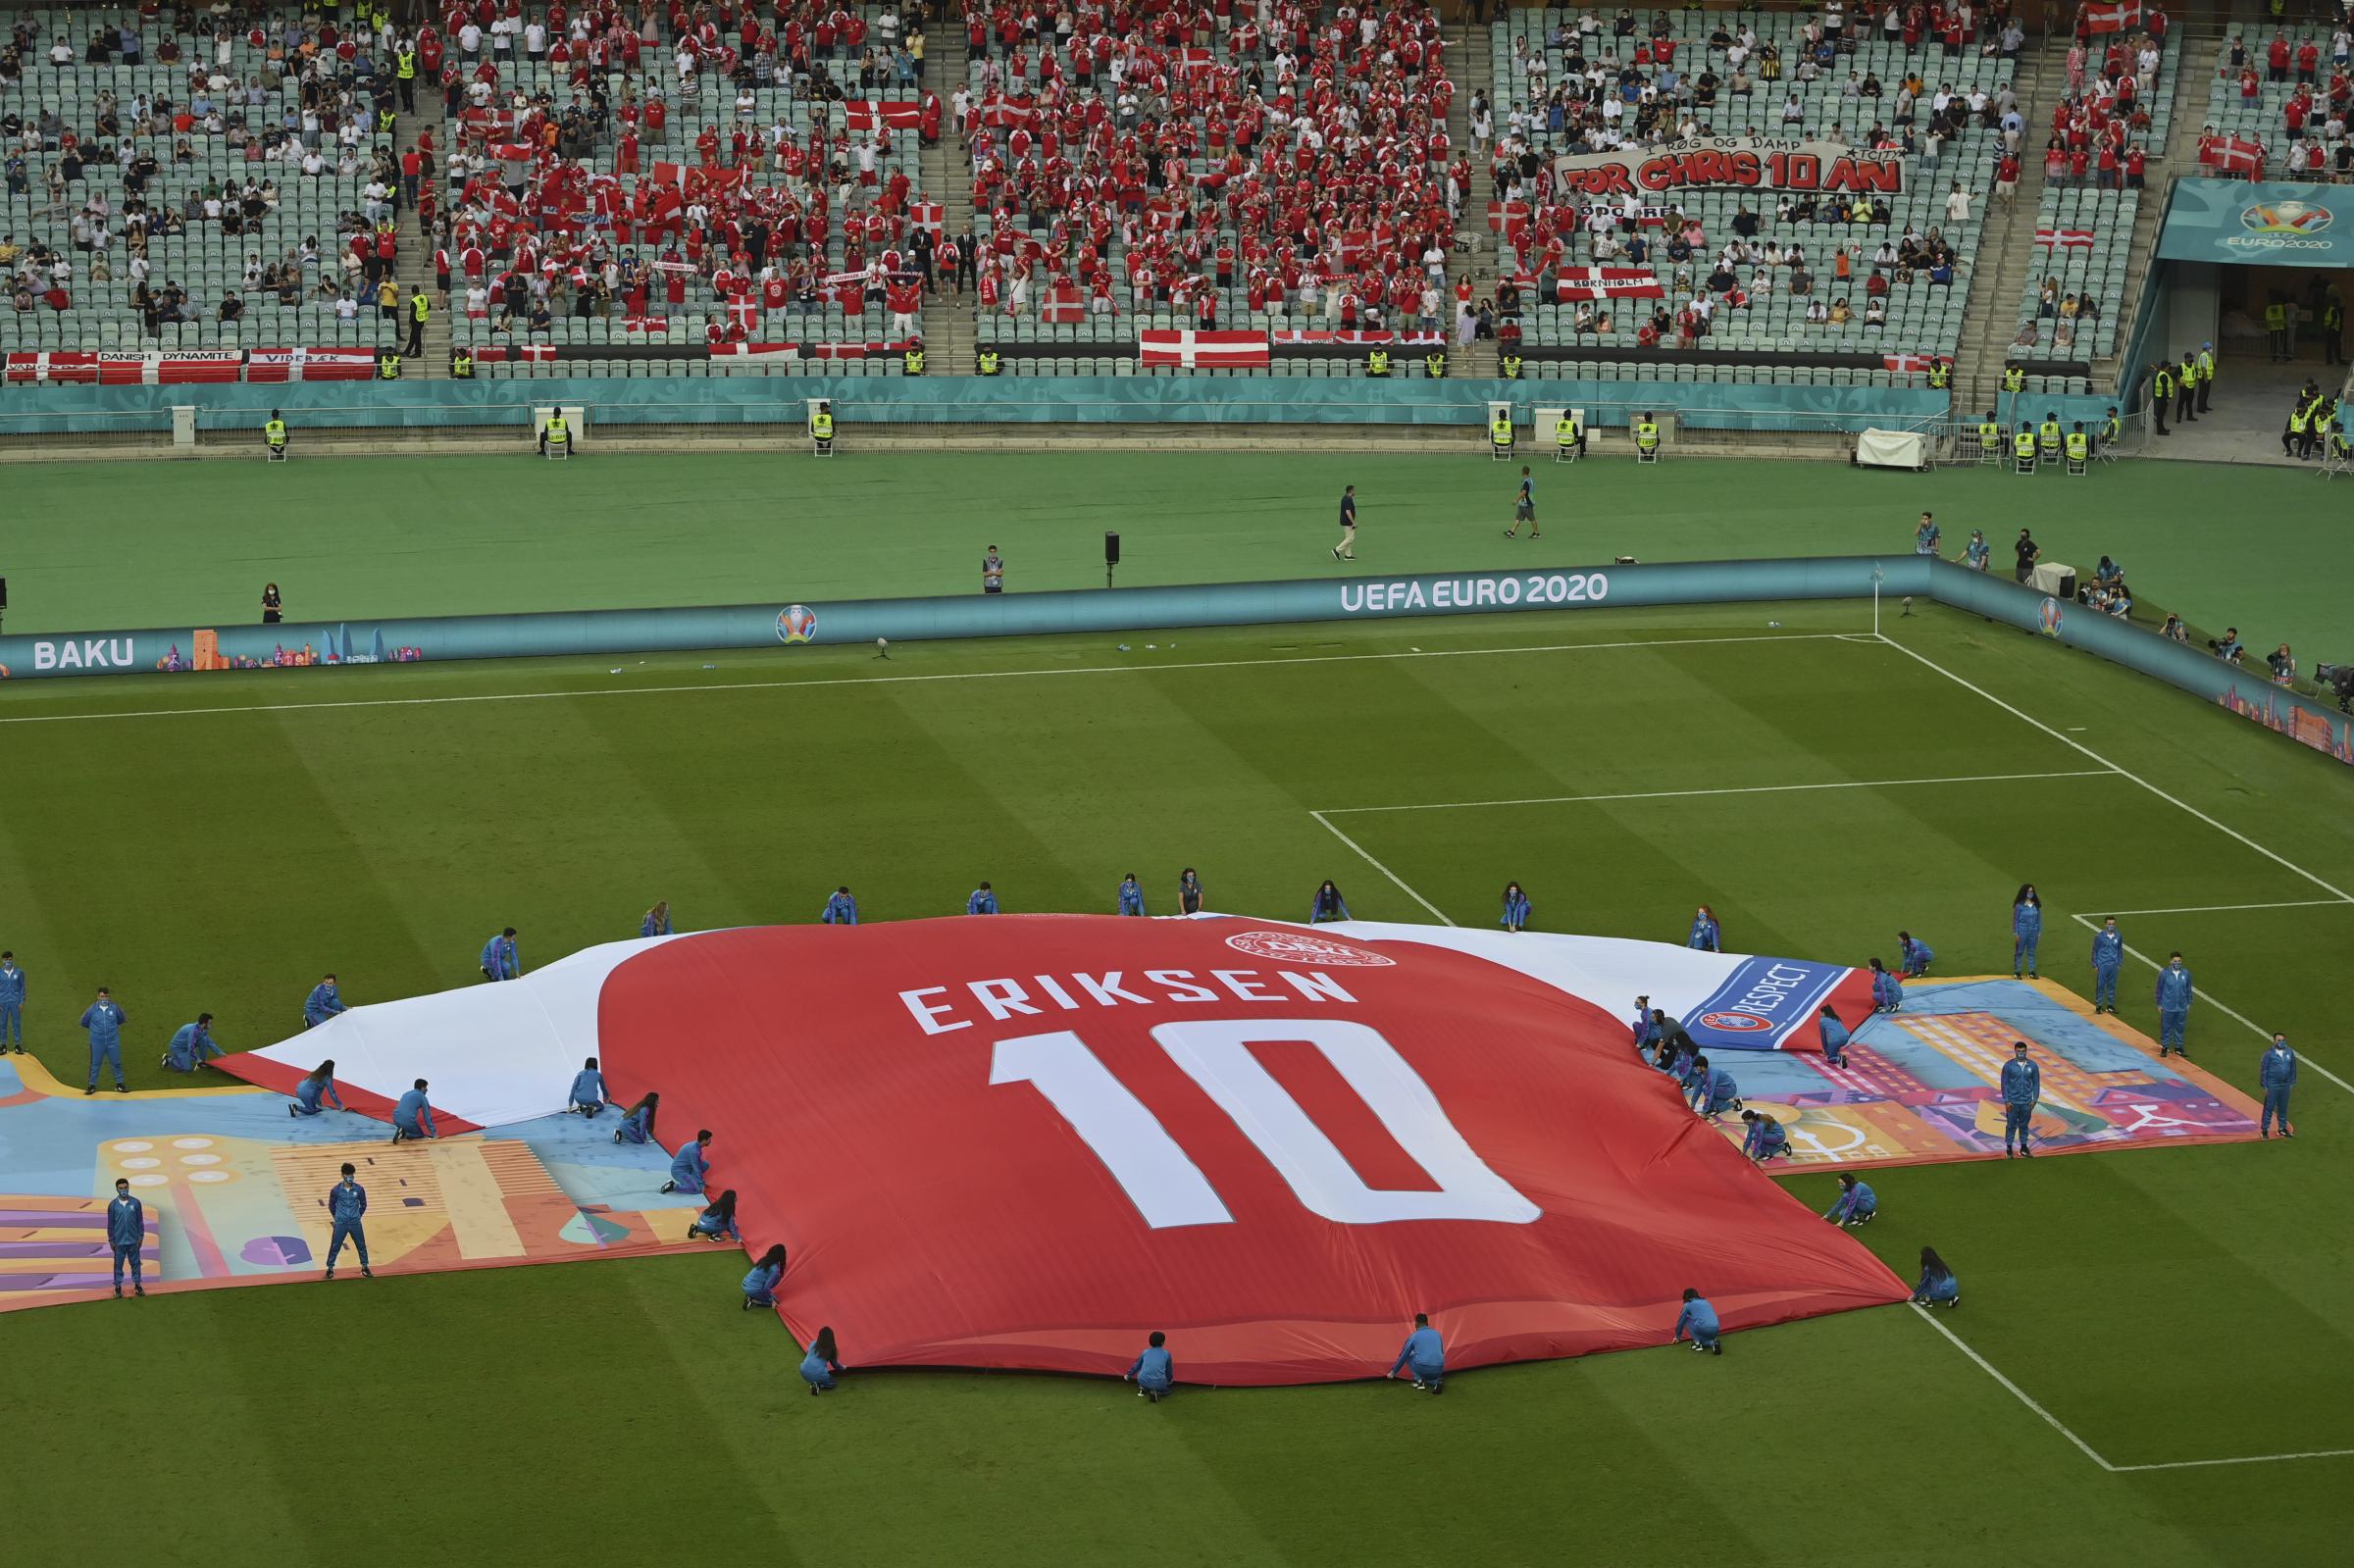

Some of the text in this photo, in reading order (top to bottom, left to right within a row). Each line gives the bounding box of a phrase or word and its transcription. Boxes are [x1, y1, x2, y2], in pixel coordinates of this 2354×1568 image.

[1666, 138, 1702, 151] RØG
[1714, 137, 1737, 147] OG
[1750, 136, 1801, 151] DAMP
[1561, 148, 1902, 199] FOR CHRIS 10 AN
[163, 352, 234, 361] DYNAMITE
[1341, 573, 1609, 612] UEFA EURO 2020
[34, 637, 133, 670] BAKU
[898, 970, 1359, 1036] ERIKSEN
[1731, 964, 1812, 1016] RESPECT
[989, 1018, 1544, 1230] 10
